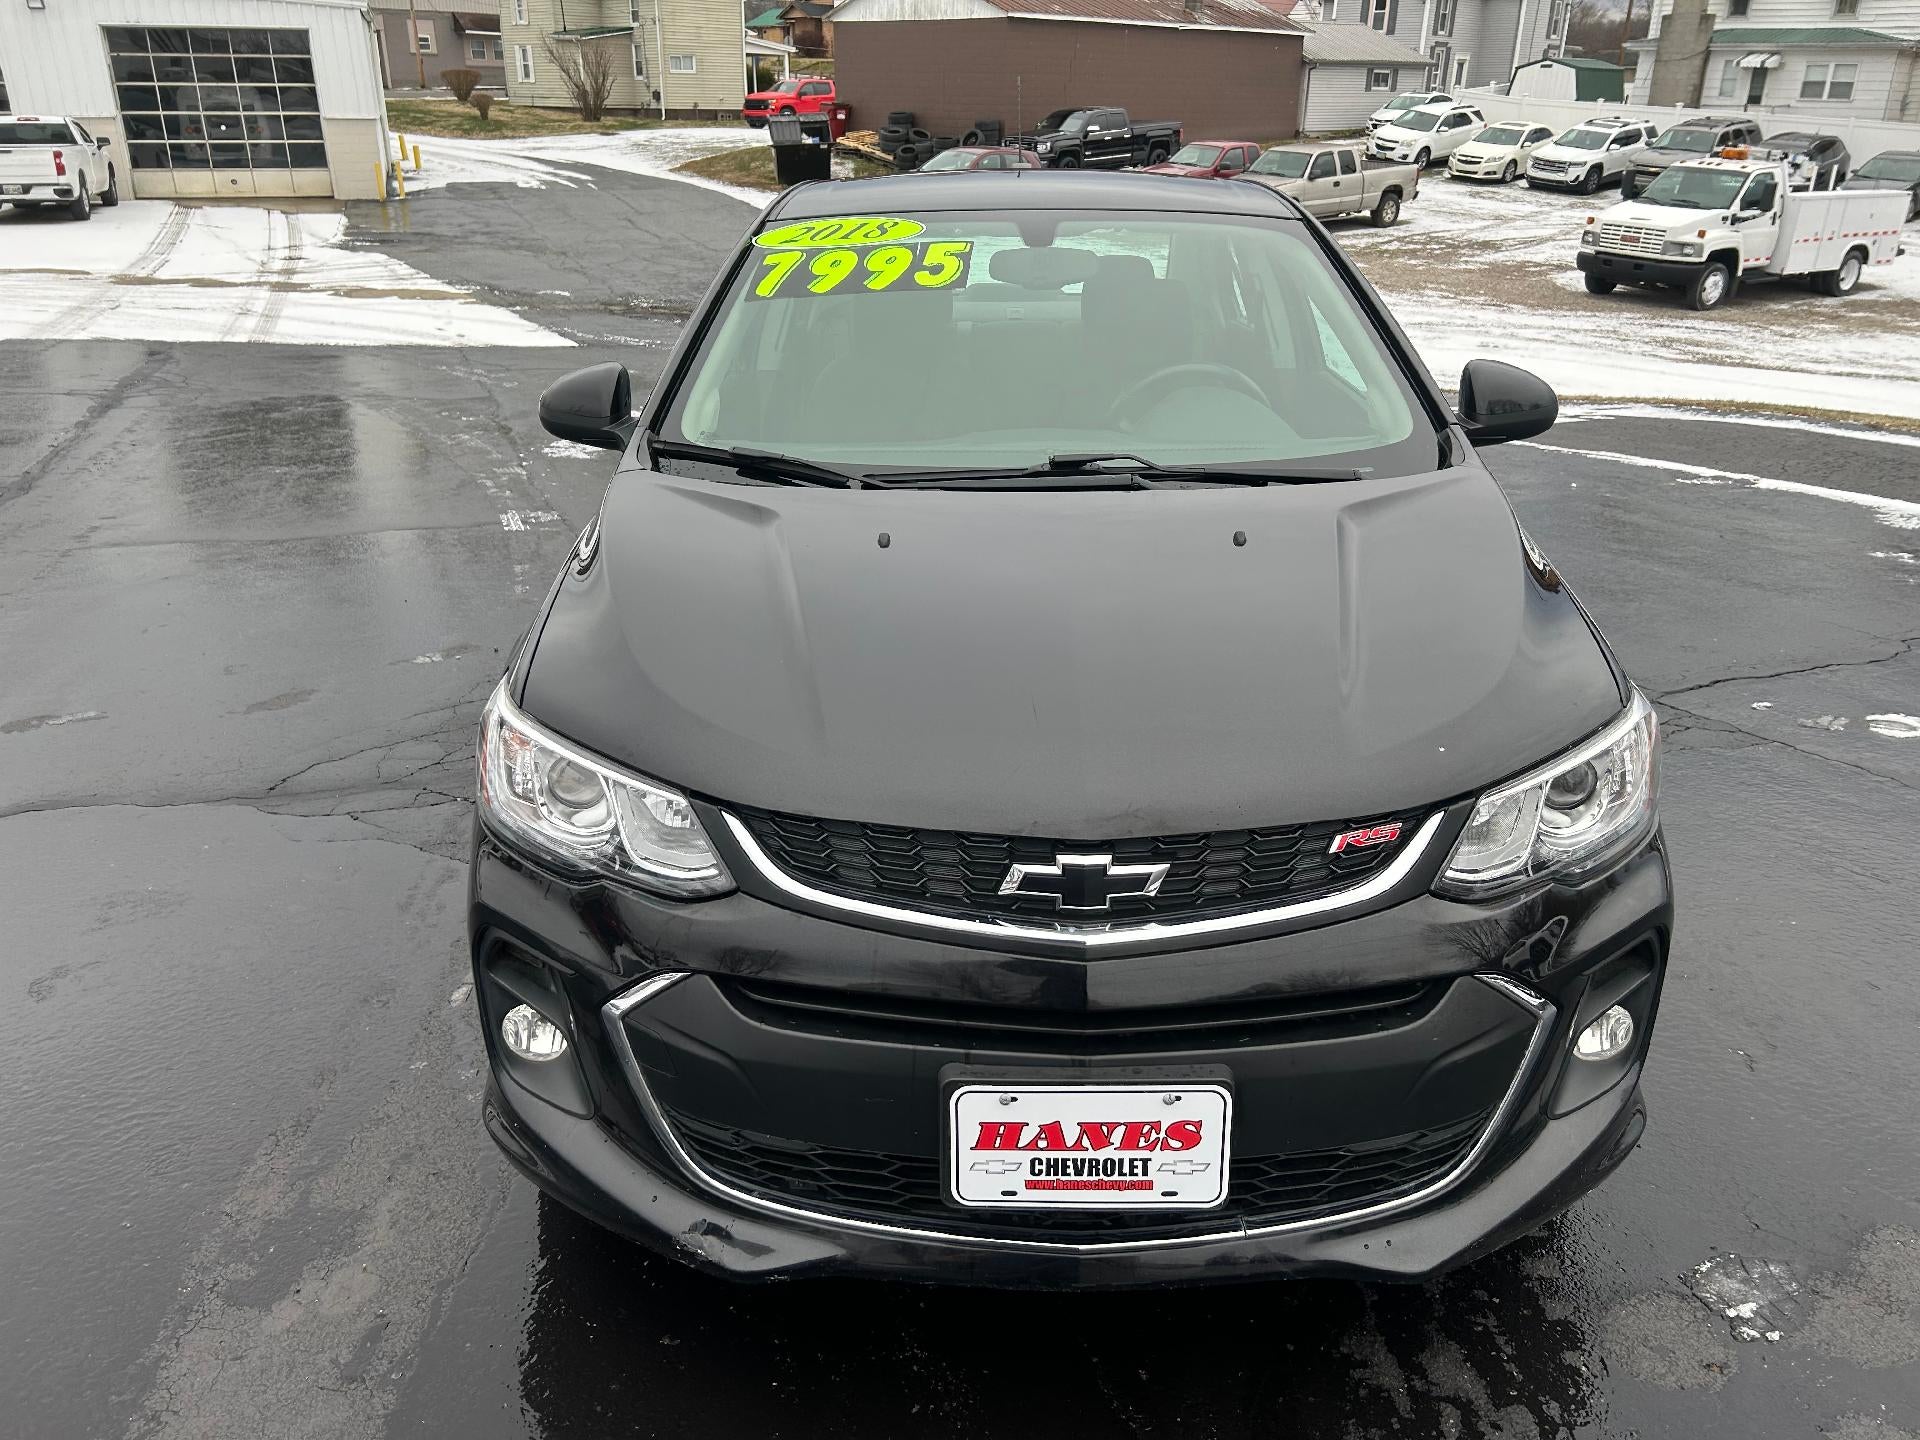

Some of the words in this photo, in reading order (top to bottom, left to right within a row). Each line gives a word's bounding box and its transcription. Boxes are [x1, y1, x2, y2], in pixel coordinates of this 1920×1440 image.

[778, 221, 900, 244] 2018
[755, 241, 971, 298] 7995
[1329, 822, 1402, 854] RS
[970, 1120, 1203, 1152] HANES
[1029, 1157, 1152, 1177] CHEVROLET
[1024, 1179, 1153, 1190] www.haneschevy.com
